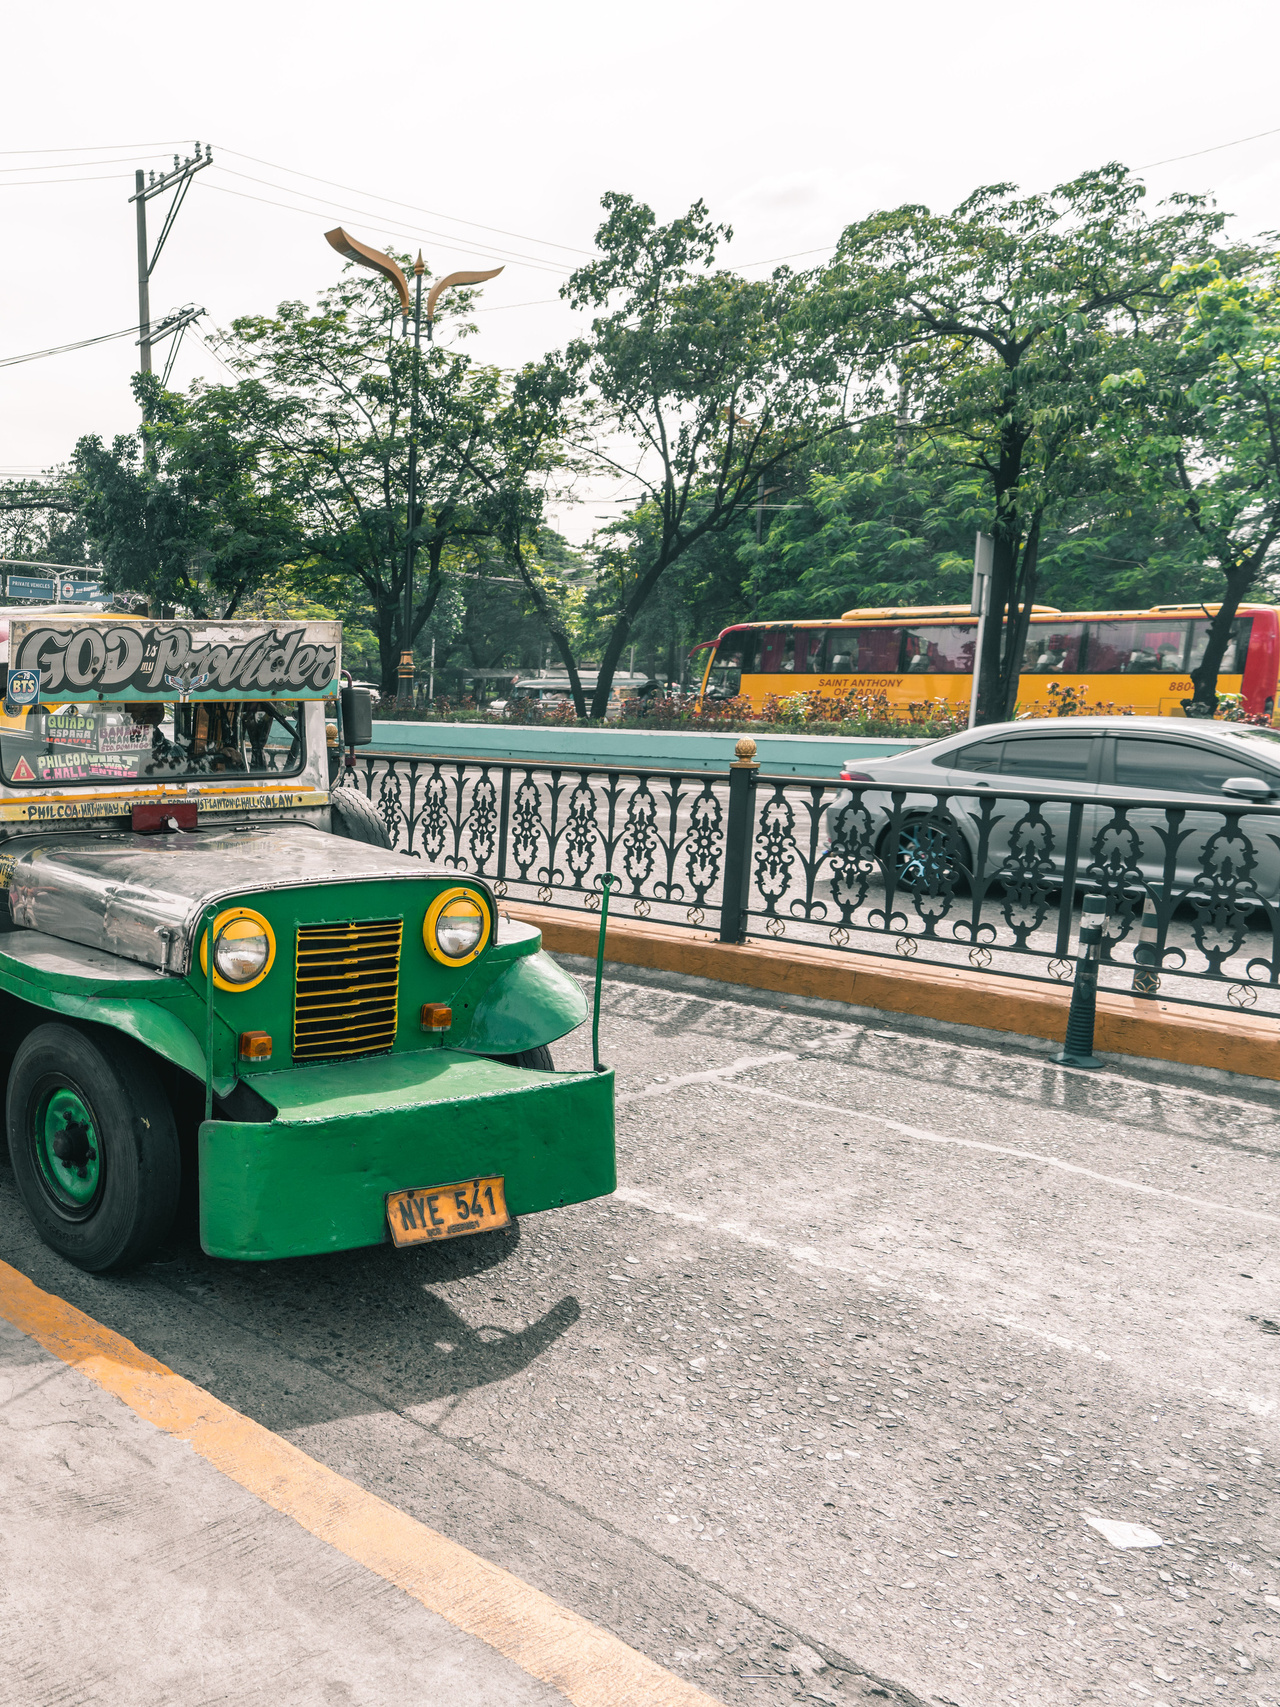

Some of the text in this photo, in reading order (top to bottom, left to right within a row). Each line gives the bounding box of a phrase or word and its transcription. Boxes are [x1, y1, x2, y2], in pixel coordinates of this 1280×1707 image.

[143, 643, 158, 658] is
[19, 627, 144, 692] GOD
[140, 662, 155, 674] my
[12, 680, 35, 694] BTS
[818, 678, 904, 688] SAINT ANTHONY
[833, 688, 888, 696] OF ADUA
[47, 715, 95, 730] QUIAPO
[49, 728, 91, 739] ESPAÑA
[38, 751, 88, 768] PHILCOA
[89, 767, 138, 778] ENTRIS
[259, 793, 294, 809] KALAW
[28, 804, 78, 820] PHILCOA
[399, 1186, 496, 1231] NYE 541
